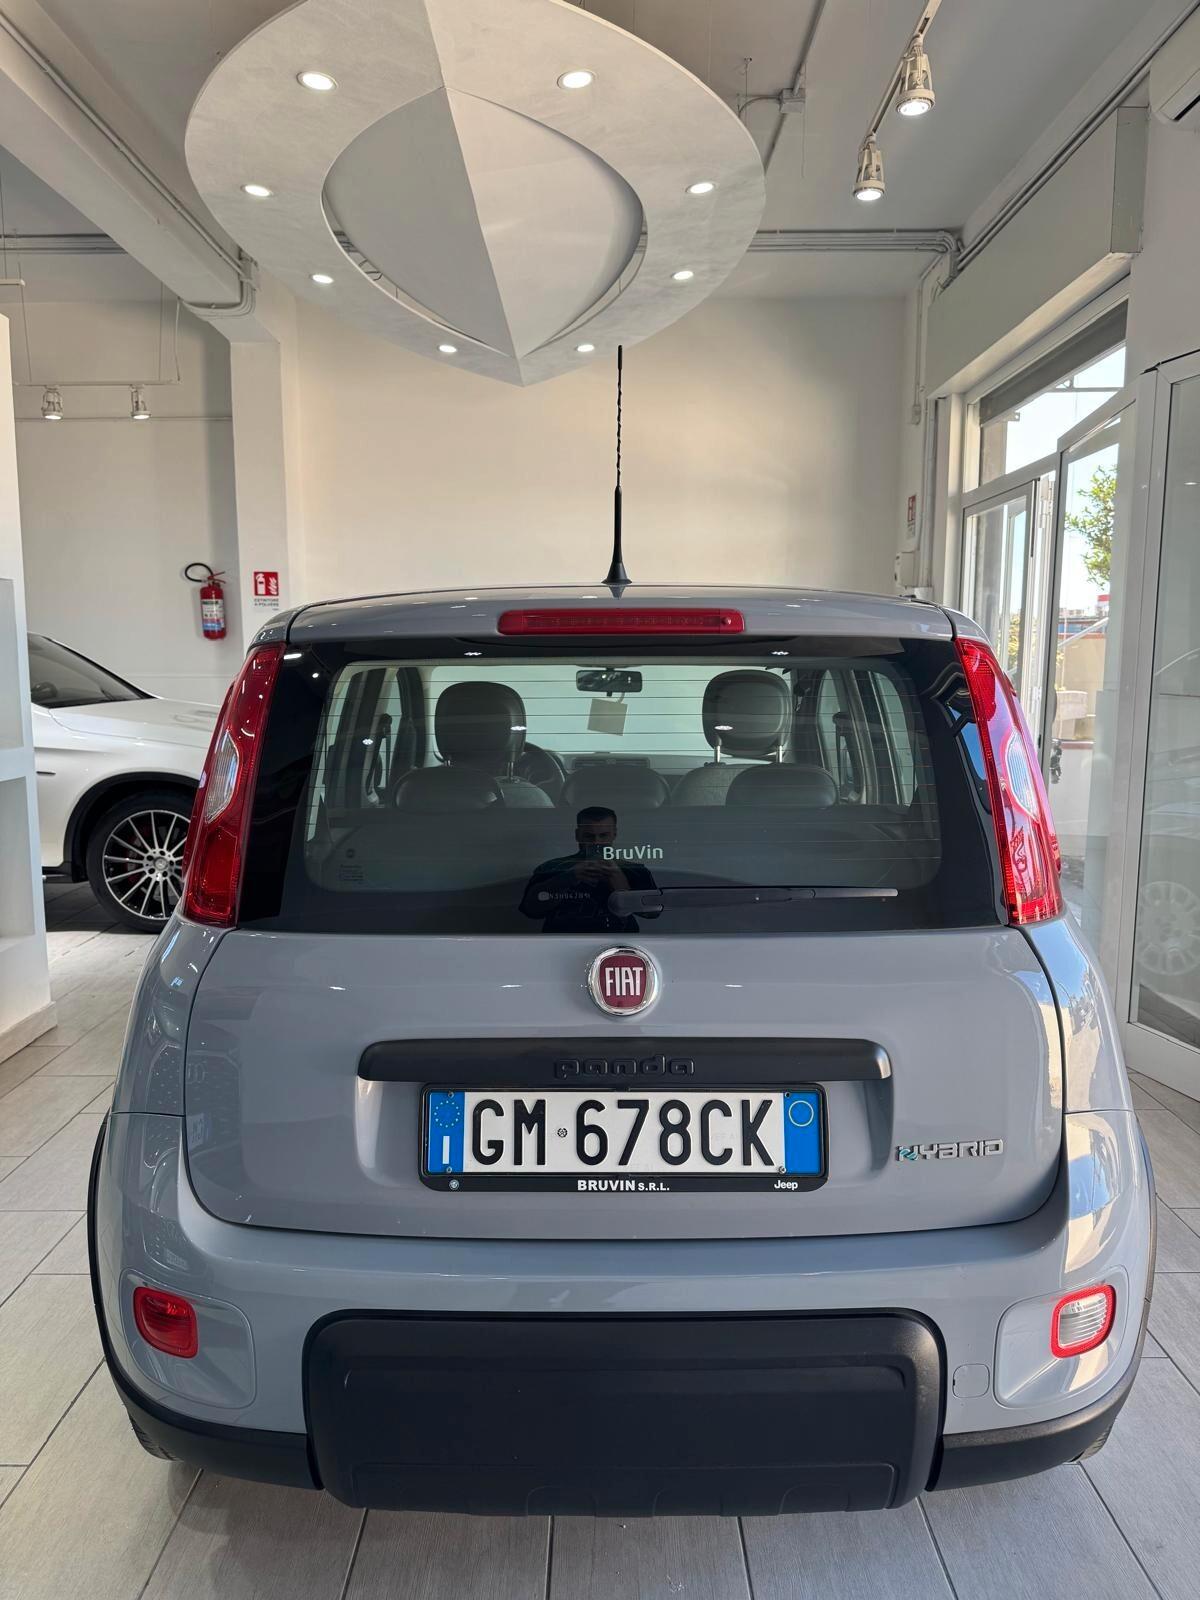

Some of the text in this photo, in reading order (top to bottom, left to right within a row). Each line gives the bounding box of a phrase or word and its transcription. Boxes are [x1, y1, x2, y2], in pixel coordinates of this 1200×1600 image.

[603, 844, 663, 860] BruVin
[605, 967, 643, 996] FIAT
[555, 1055, 695, 1079] panda
[577, 1179, 670, 1191] BRUVIN S.R.L.
[774, 1179, 799, 1191] Jeep
